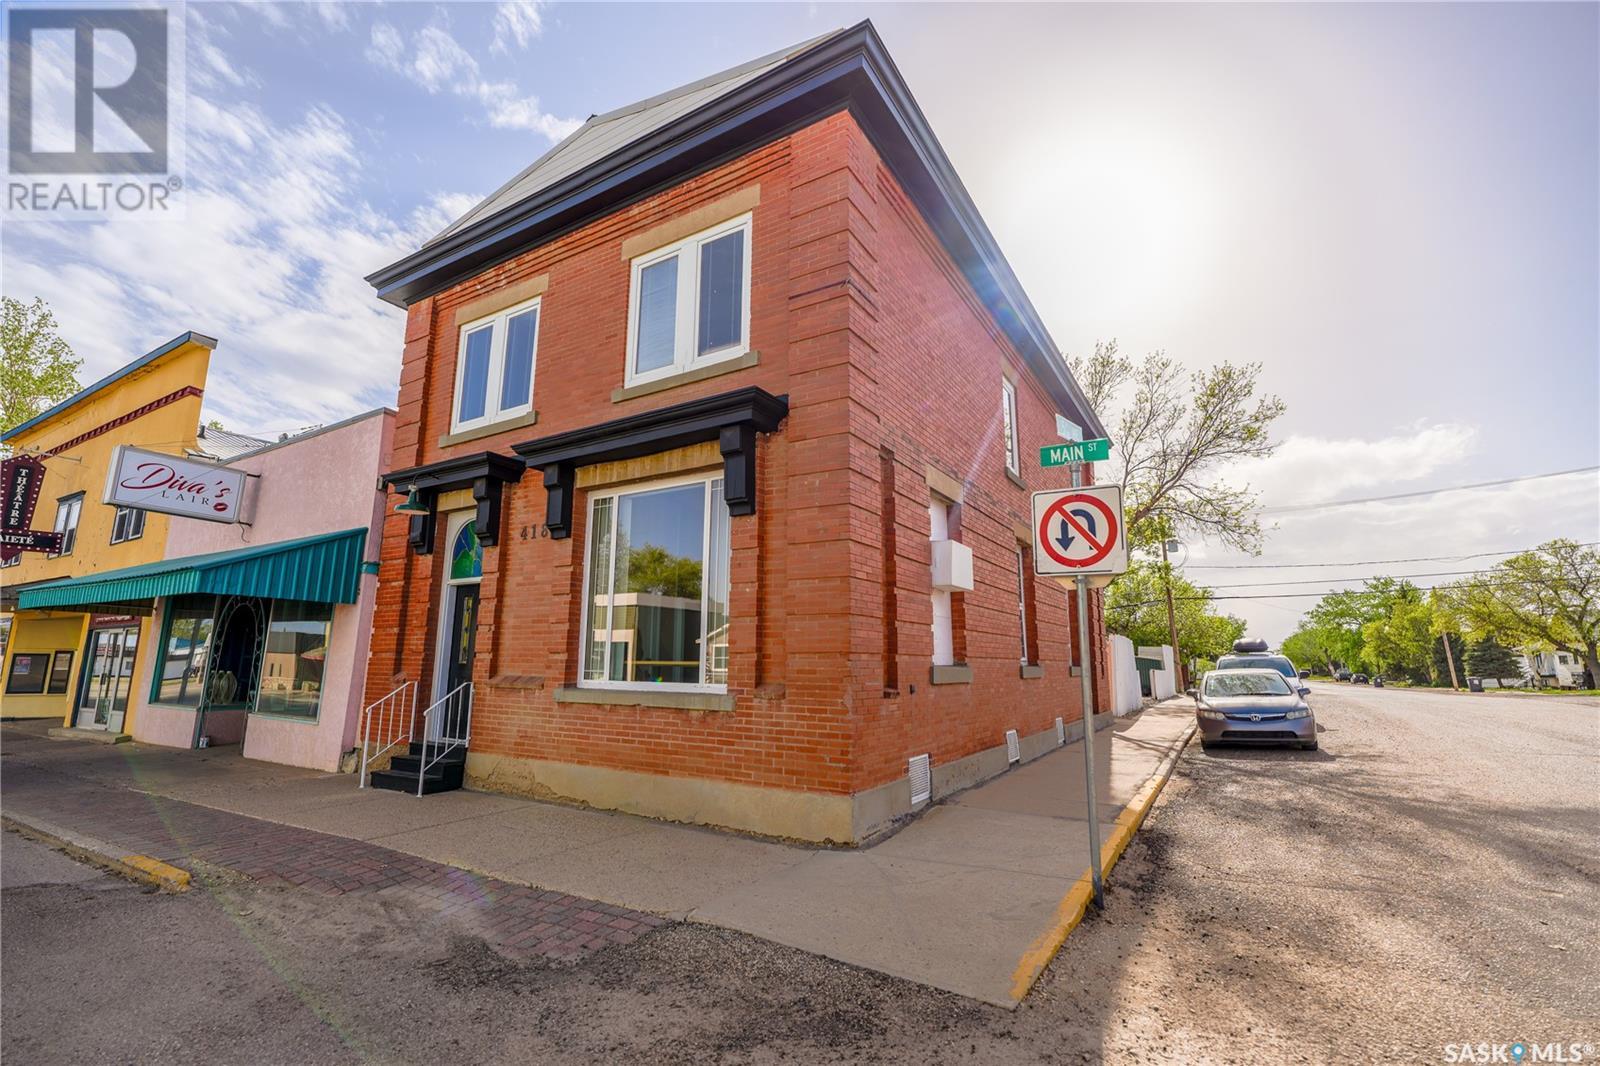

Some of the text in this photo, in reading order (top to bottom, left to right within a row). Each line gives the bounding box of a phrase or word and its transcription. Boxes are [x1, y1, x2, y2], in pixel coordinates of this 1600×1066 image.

[1050, 443, 1097, 464] MAIN ST
[120, 462, 231, 498] Diva's
[161, 489, 209, 506] LAIR
